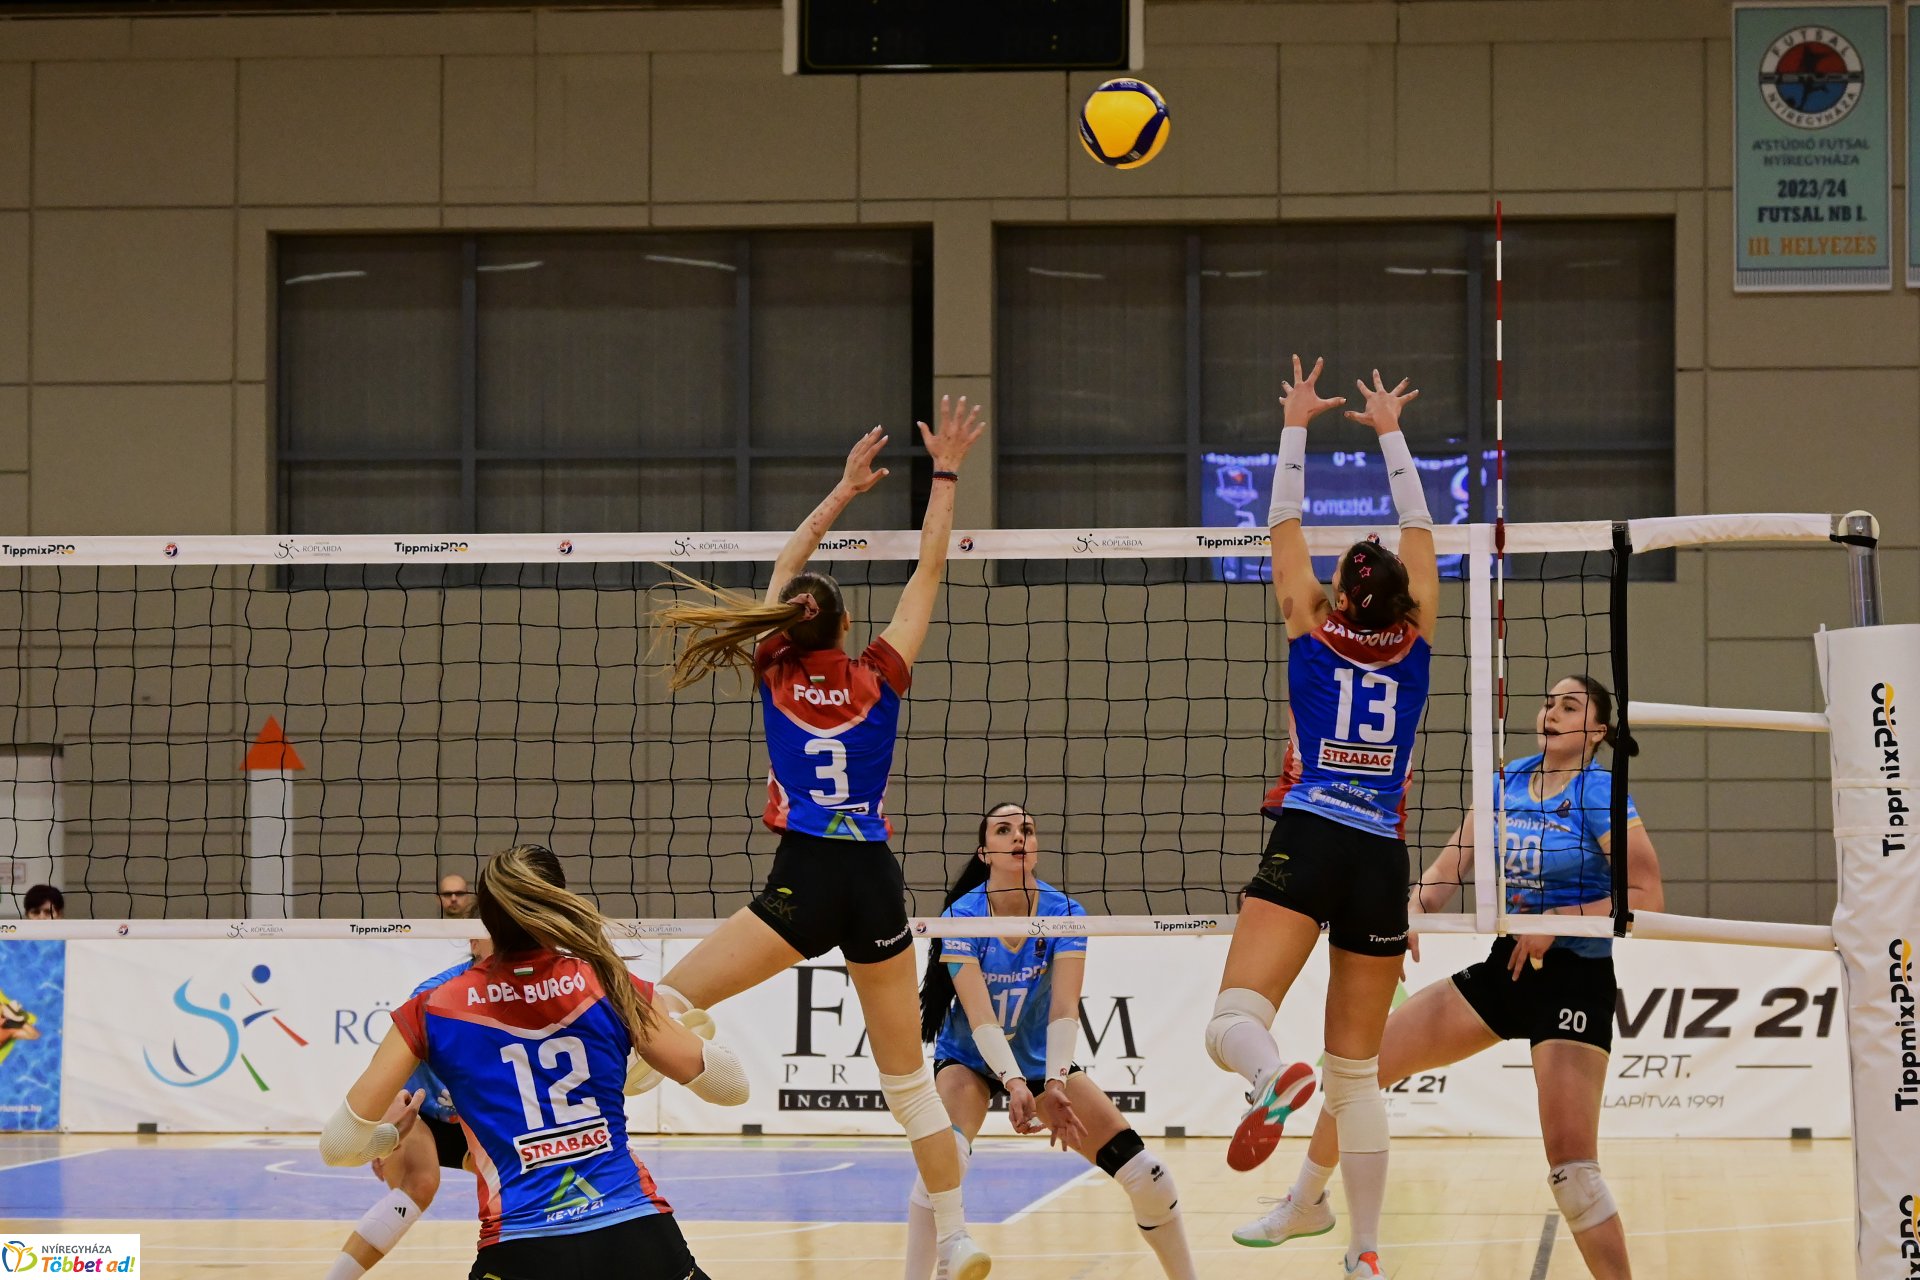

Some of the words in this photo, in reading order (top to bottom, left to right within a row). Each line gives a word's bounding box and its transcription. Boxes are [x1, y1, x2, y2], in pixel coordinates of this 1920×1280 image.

[1772, 29, 1850, 58] FUTSAL
[1820, 138, 1870, 150] FUTSAL
[1777, 178, 1847, 199] 2023/24
[1758, 206, 1824, 223] FUTSAL
[1828, 206, 1852, 222] NB
[2, 544, 76, 558] TippmixPRO
[394, 542, 469, 555] TippmixPRO
[818, 539, 868, 550] mixPRO
[793, 683, 852, 707] FÖLDI
[1333, 668, 1399, 744] 13
[1322, 749, 1392, 767] STRABAG
[804, 738, 850, 806] 3
[1503, 832, 1543, 876] 20
[349, 924, 412, 936] TippmixPRO
[1153, 920, 1217, 932] TippmixPRO
[467, 986, 487, 1007] A.
[523, 971, 586, 1005] BURGO
[993, 988, 1029, 1028] 17
[1615, 987, 1740, 1039] VIZ
[1754, 986, 1840, 1039] 21
[1558, 1007, 1588, 1034] 20
[1889, 938, 1920, 1113] TippmixPRO
[1618, 1054, 1692, 1079] ZRT.
[500, 1035, 602, 1131] 12
[1417, 1075, 1447, 1093] 21
[1603, 1092, 1683, 1109] LAPÍTVA
[1687, 1094, 1725, 1109] 1991
[520, 1128, 609, 1163] STRABAG
[546, 1203, 589, 1223] KE-VIZ
